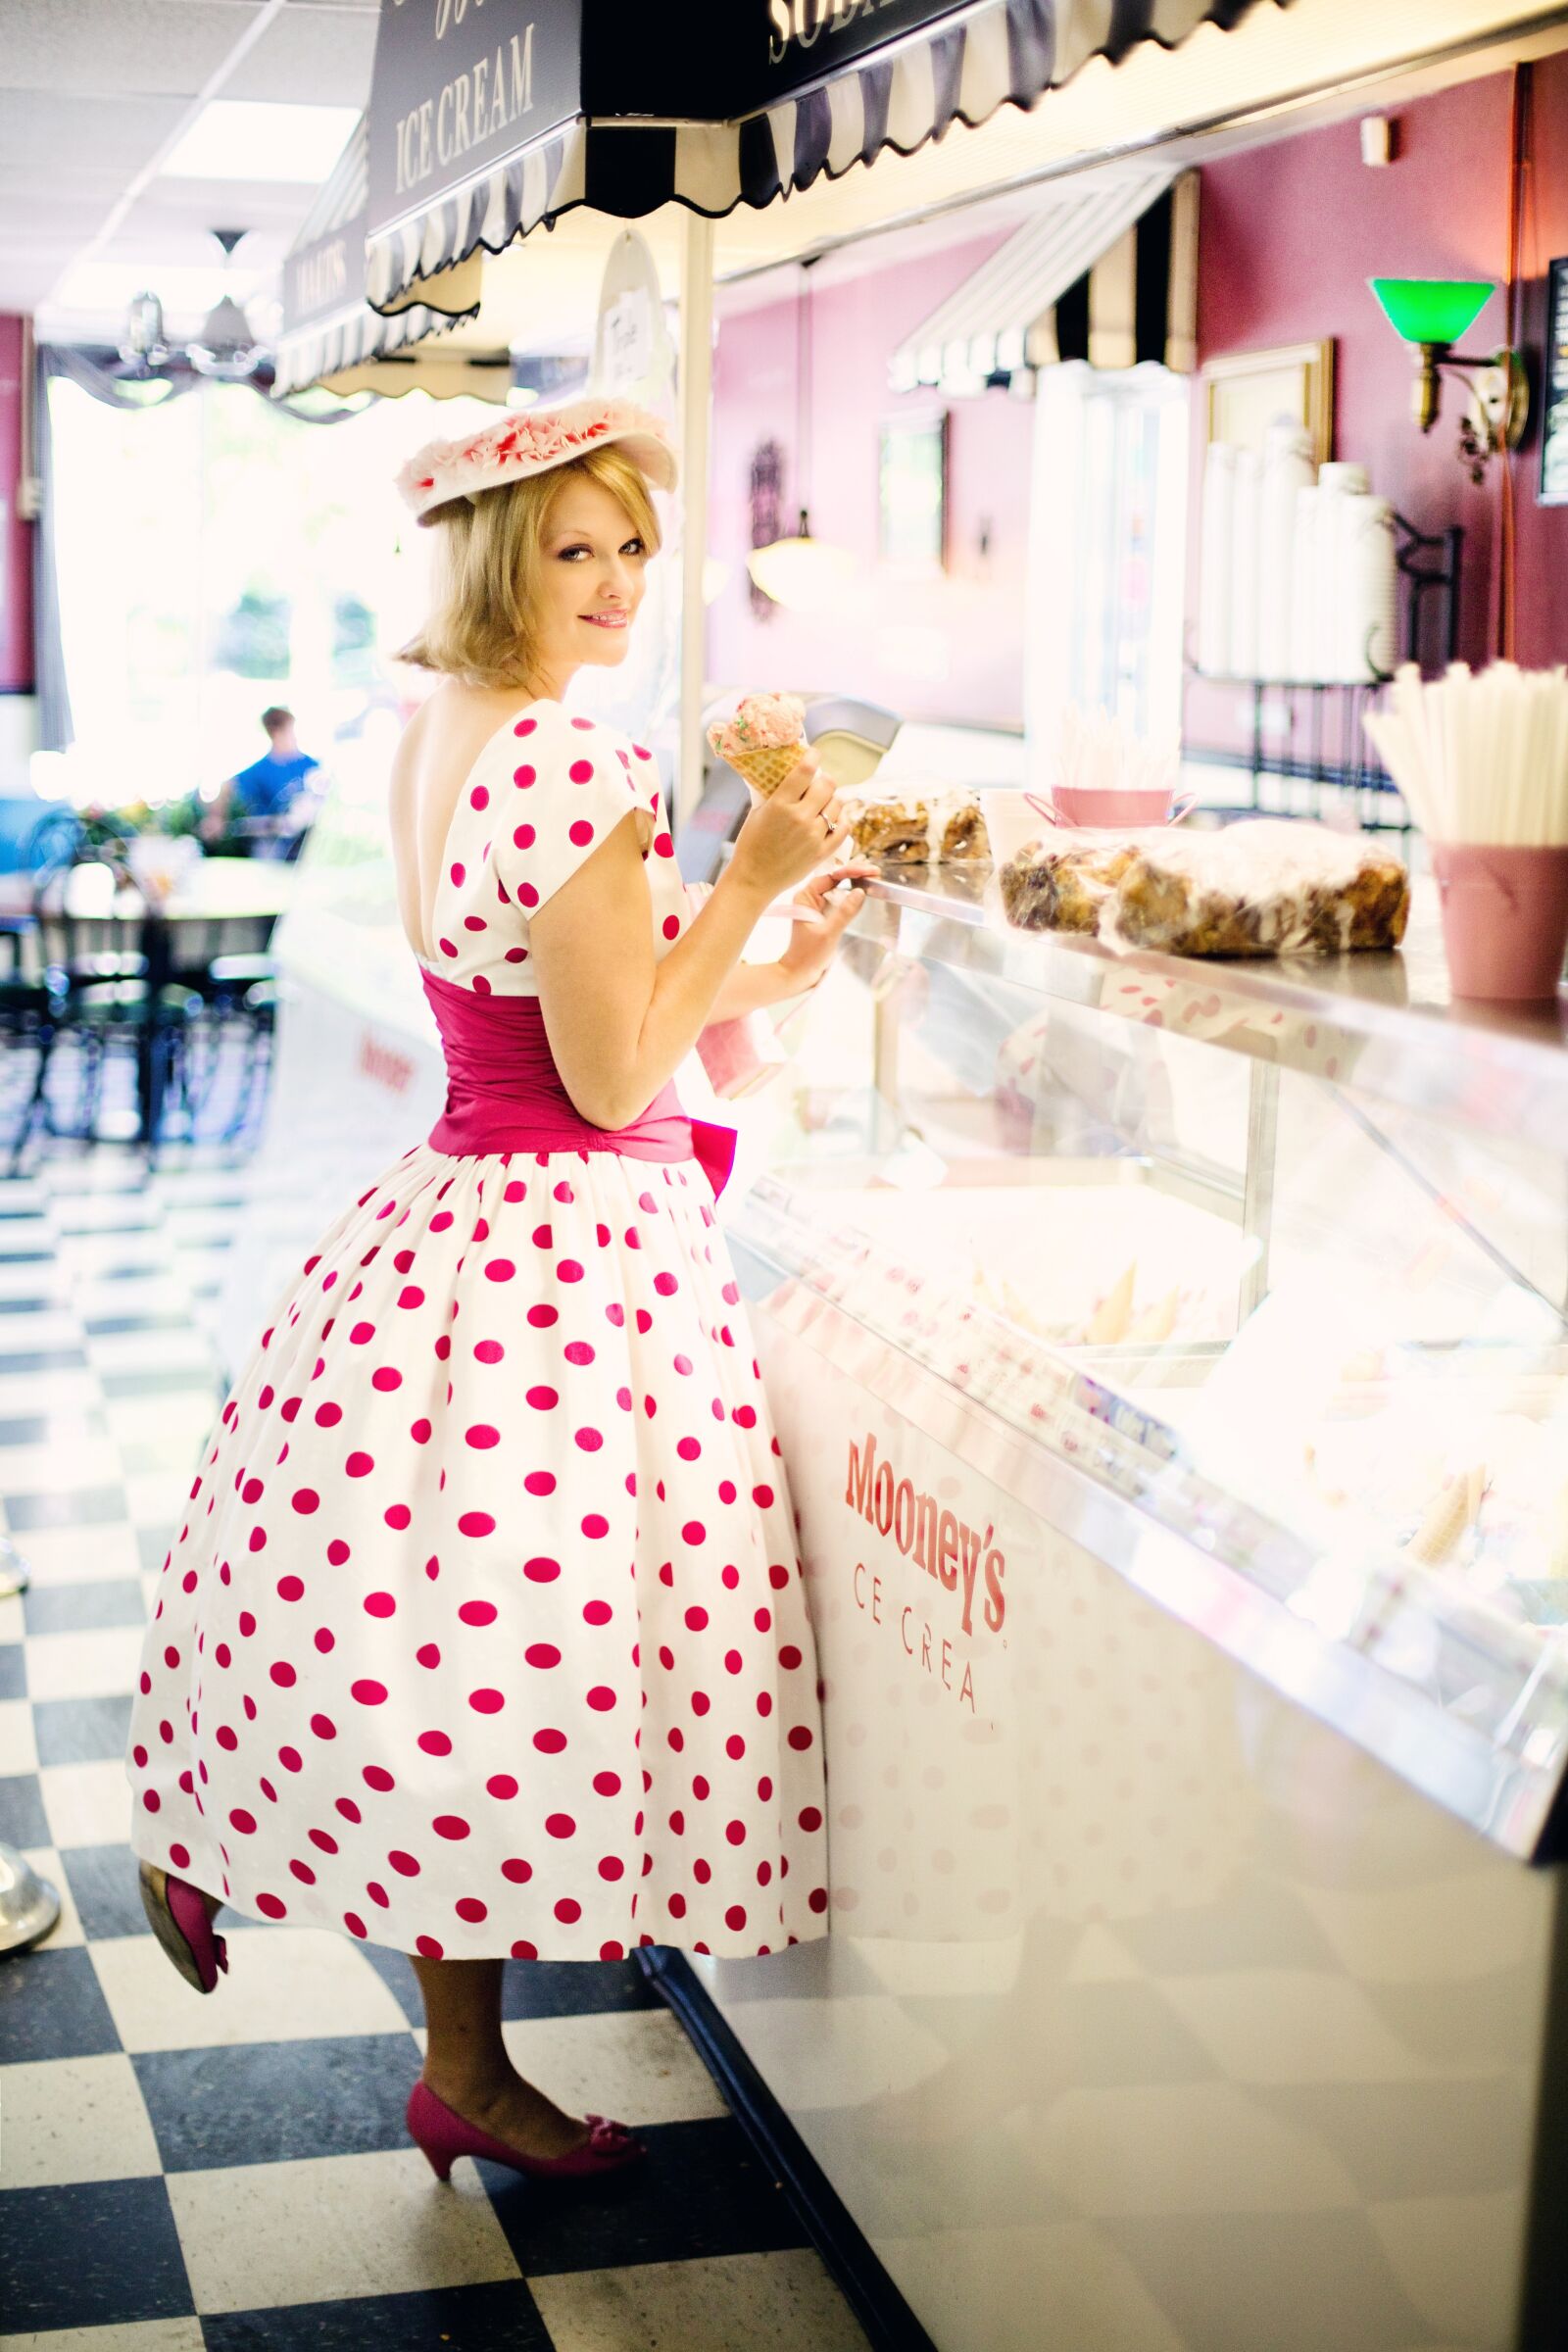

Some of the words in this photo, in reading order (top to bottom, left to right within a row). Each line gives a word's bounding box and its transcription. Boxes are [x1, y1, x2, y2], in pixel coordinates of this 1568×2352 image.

[395, 98, 434, 195] ICE
[437, 22, 535, 167] CREAM
[768, 0, 898, 65] SO
[845, 1432, 1006, 1637] Mooney's
